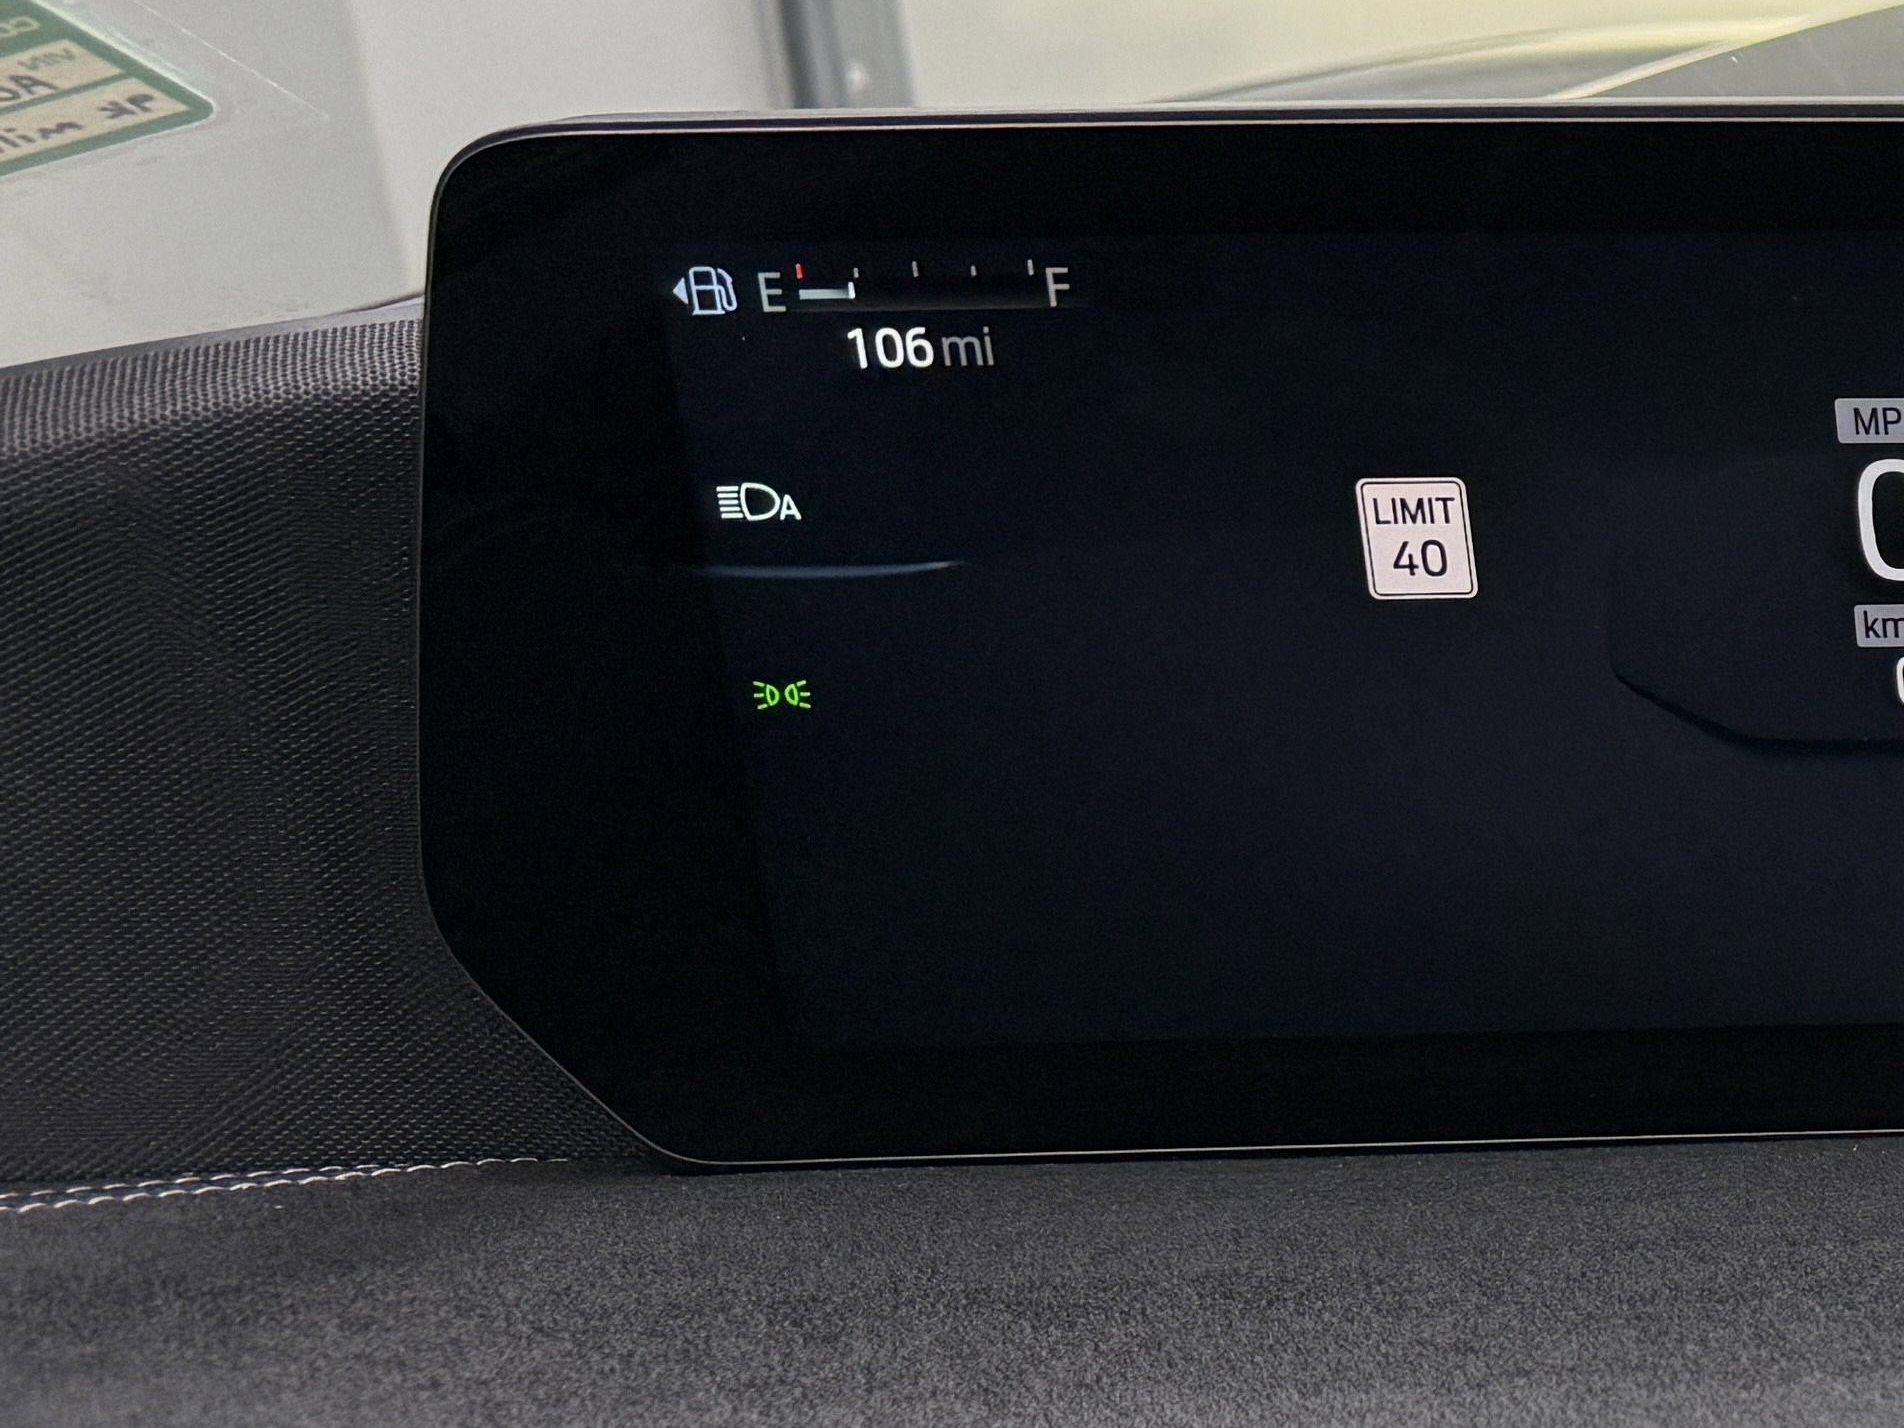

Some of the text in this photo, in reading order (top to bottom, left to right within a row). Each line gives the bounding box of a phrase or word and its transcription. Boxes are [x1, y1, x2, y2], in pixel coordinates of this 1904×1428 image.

[757, 272, 787, 313] E
[1045, 267, 1070, 307] F
[846, 326, 995, 370] 106 mi
[1372, 496, 1456, 525] LIMIT
[1392, 539, 1448, 577] 40
